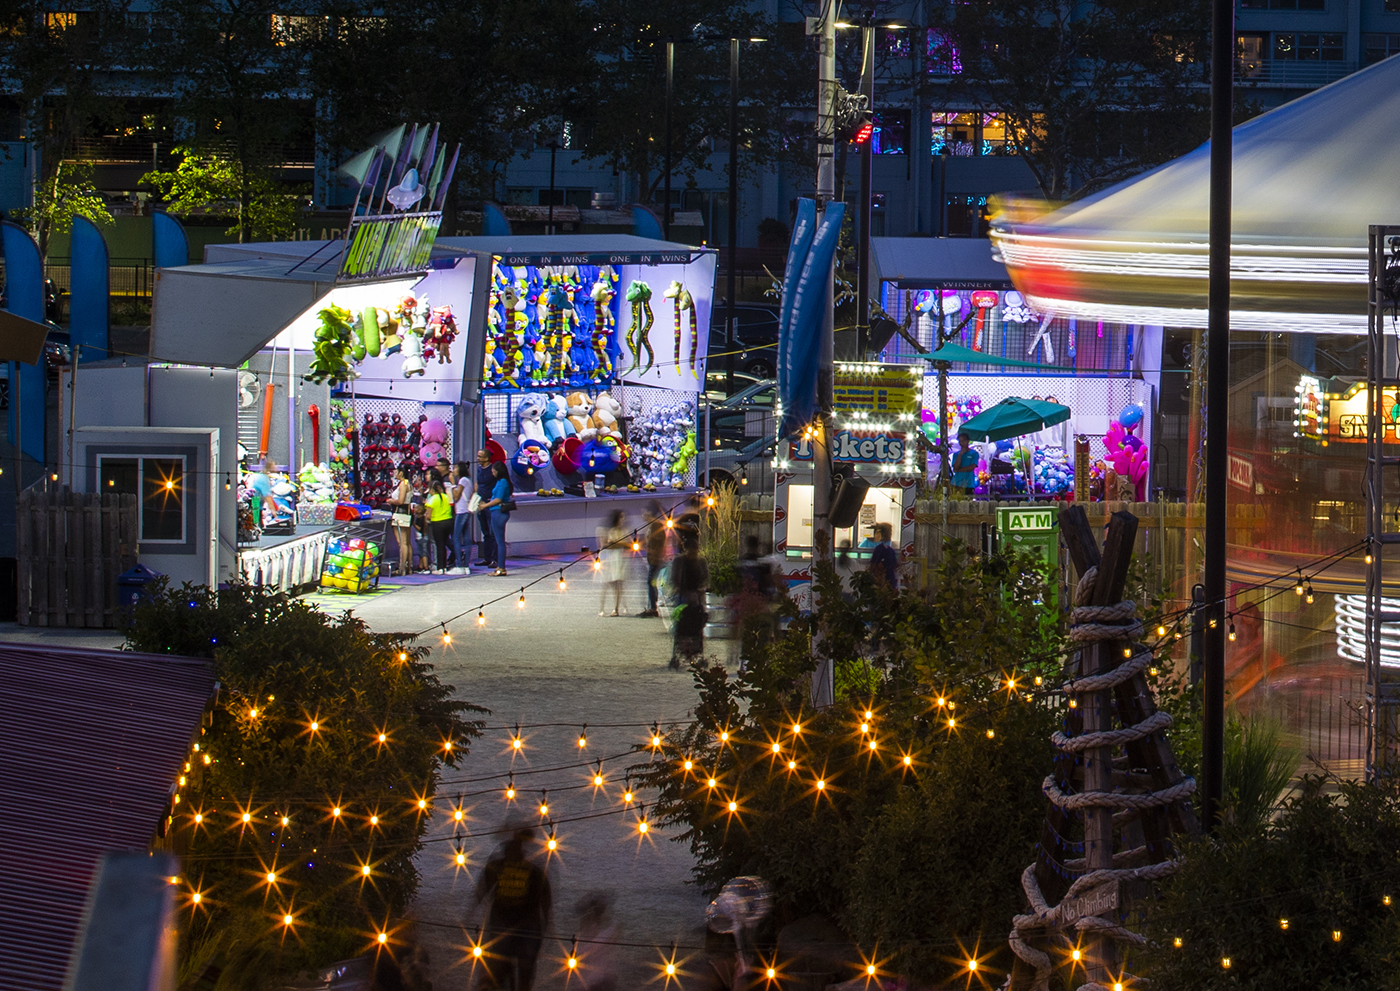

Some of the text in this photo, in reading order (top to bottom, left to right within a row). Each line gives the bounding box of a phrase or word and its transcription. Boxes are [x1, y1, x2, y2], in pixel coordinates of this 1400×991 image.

[509, 256, 530, 264] ONE
[562, 255, 589, 263] WINS
[610, 255, 630, 263] ONE
[641, 255, 651, 263] IN
[796, 431, 903, 460] Tckets
[1010, 514, 1051, 528] ATM
[1061, 891, 1117, 924] No Climbing
